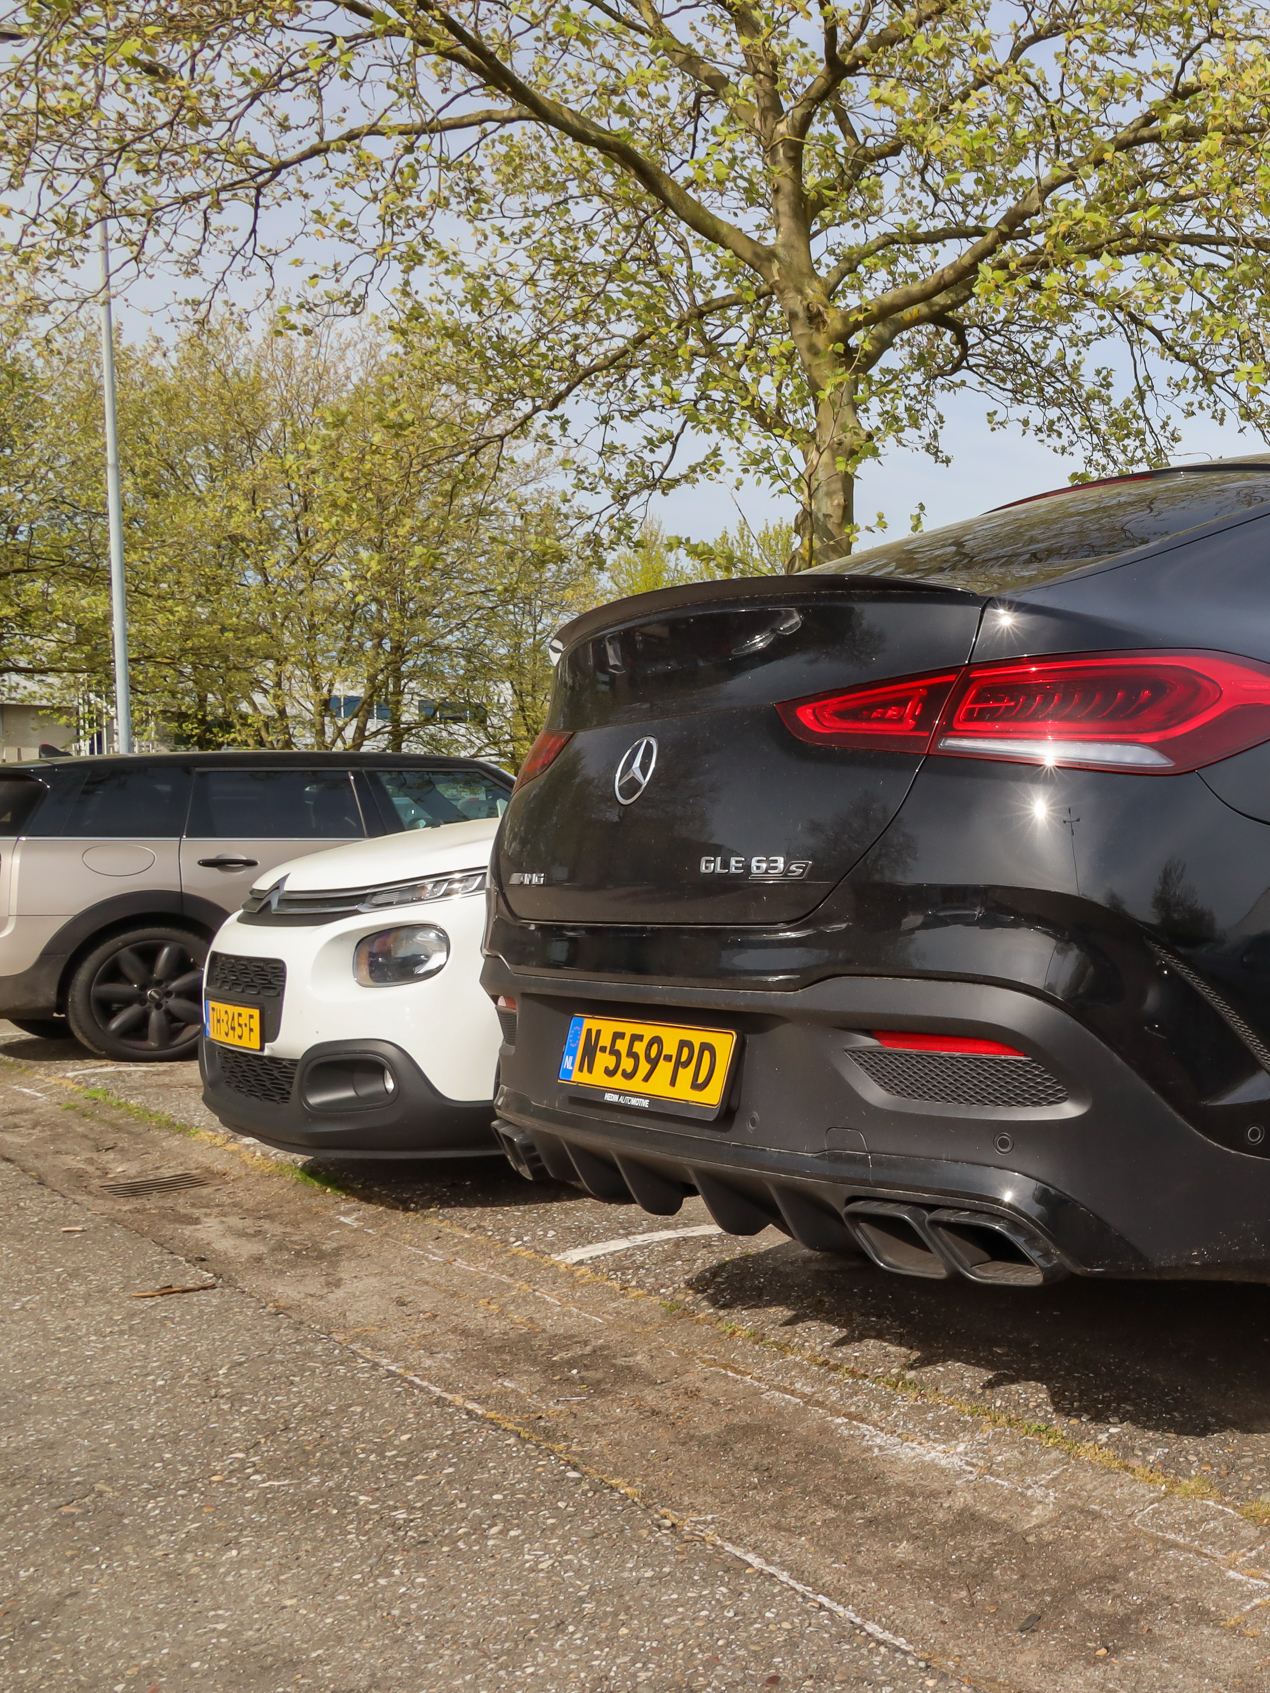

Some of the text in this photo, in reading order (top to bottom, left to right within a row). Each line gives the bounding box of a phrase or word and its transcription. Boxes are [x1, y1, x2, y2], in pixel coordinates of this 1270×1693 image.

[700, 857, 745, 873] GLE
[751, 857, 784, 873] 63
[211, 1007, 254, 1042] TH-345-F
[564, 1055, 574, 1070] NL
[578, 1028, 716, 1092] N-559-PD
[619, 1096, 649, 1108] AUTOMOTIVE
